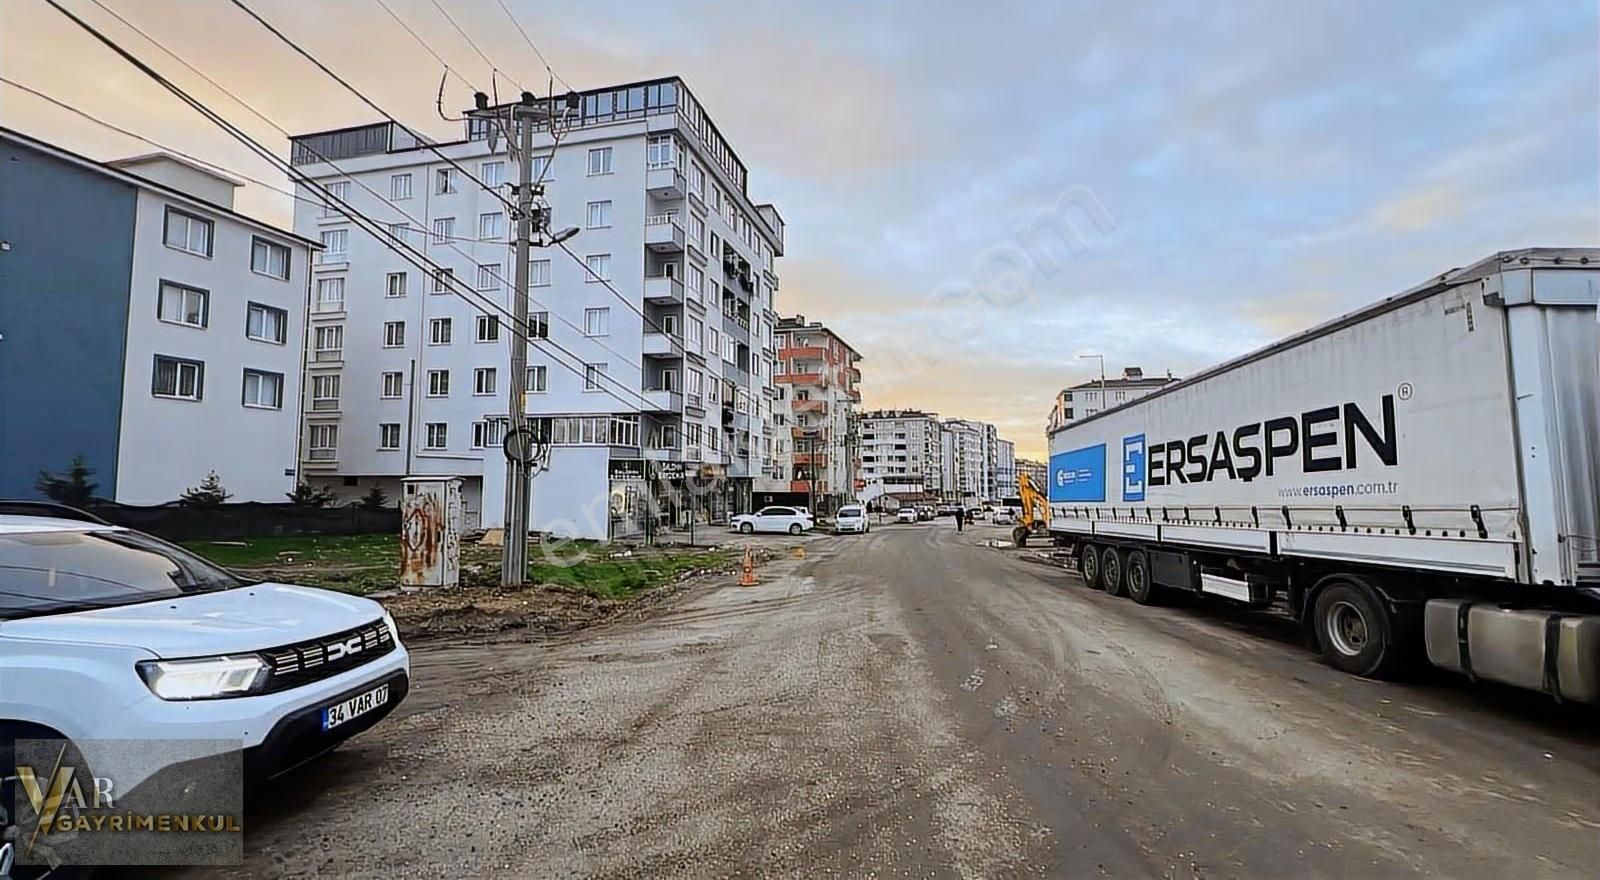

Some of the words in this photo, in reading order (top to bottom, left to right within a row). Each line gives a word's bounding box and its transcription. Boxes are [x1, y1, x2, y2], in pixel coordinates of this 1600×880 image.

[1147, 394, 1398, 487] ERSAŞPEN
[329, 705, 345, 726] 34
[348, 693, 373, 717] VAR
[375, 687, 388, 705] 07
